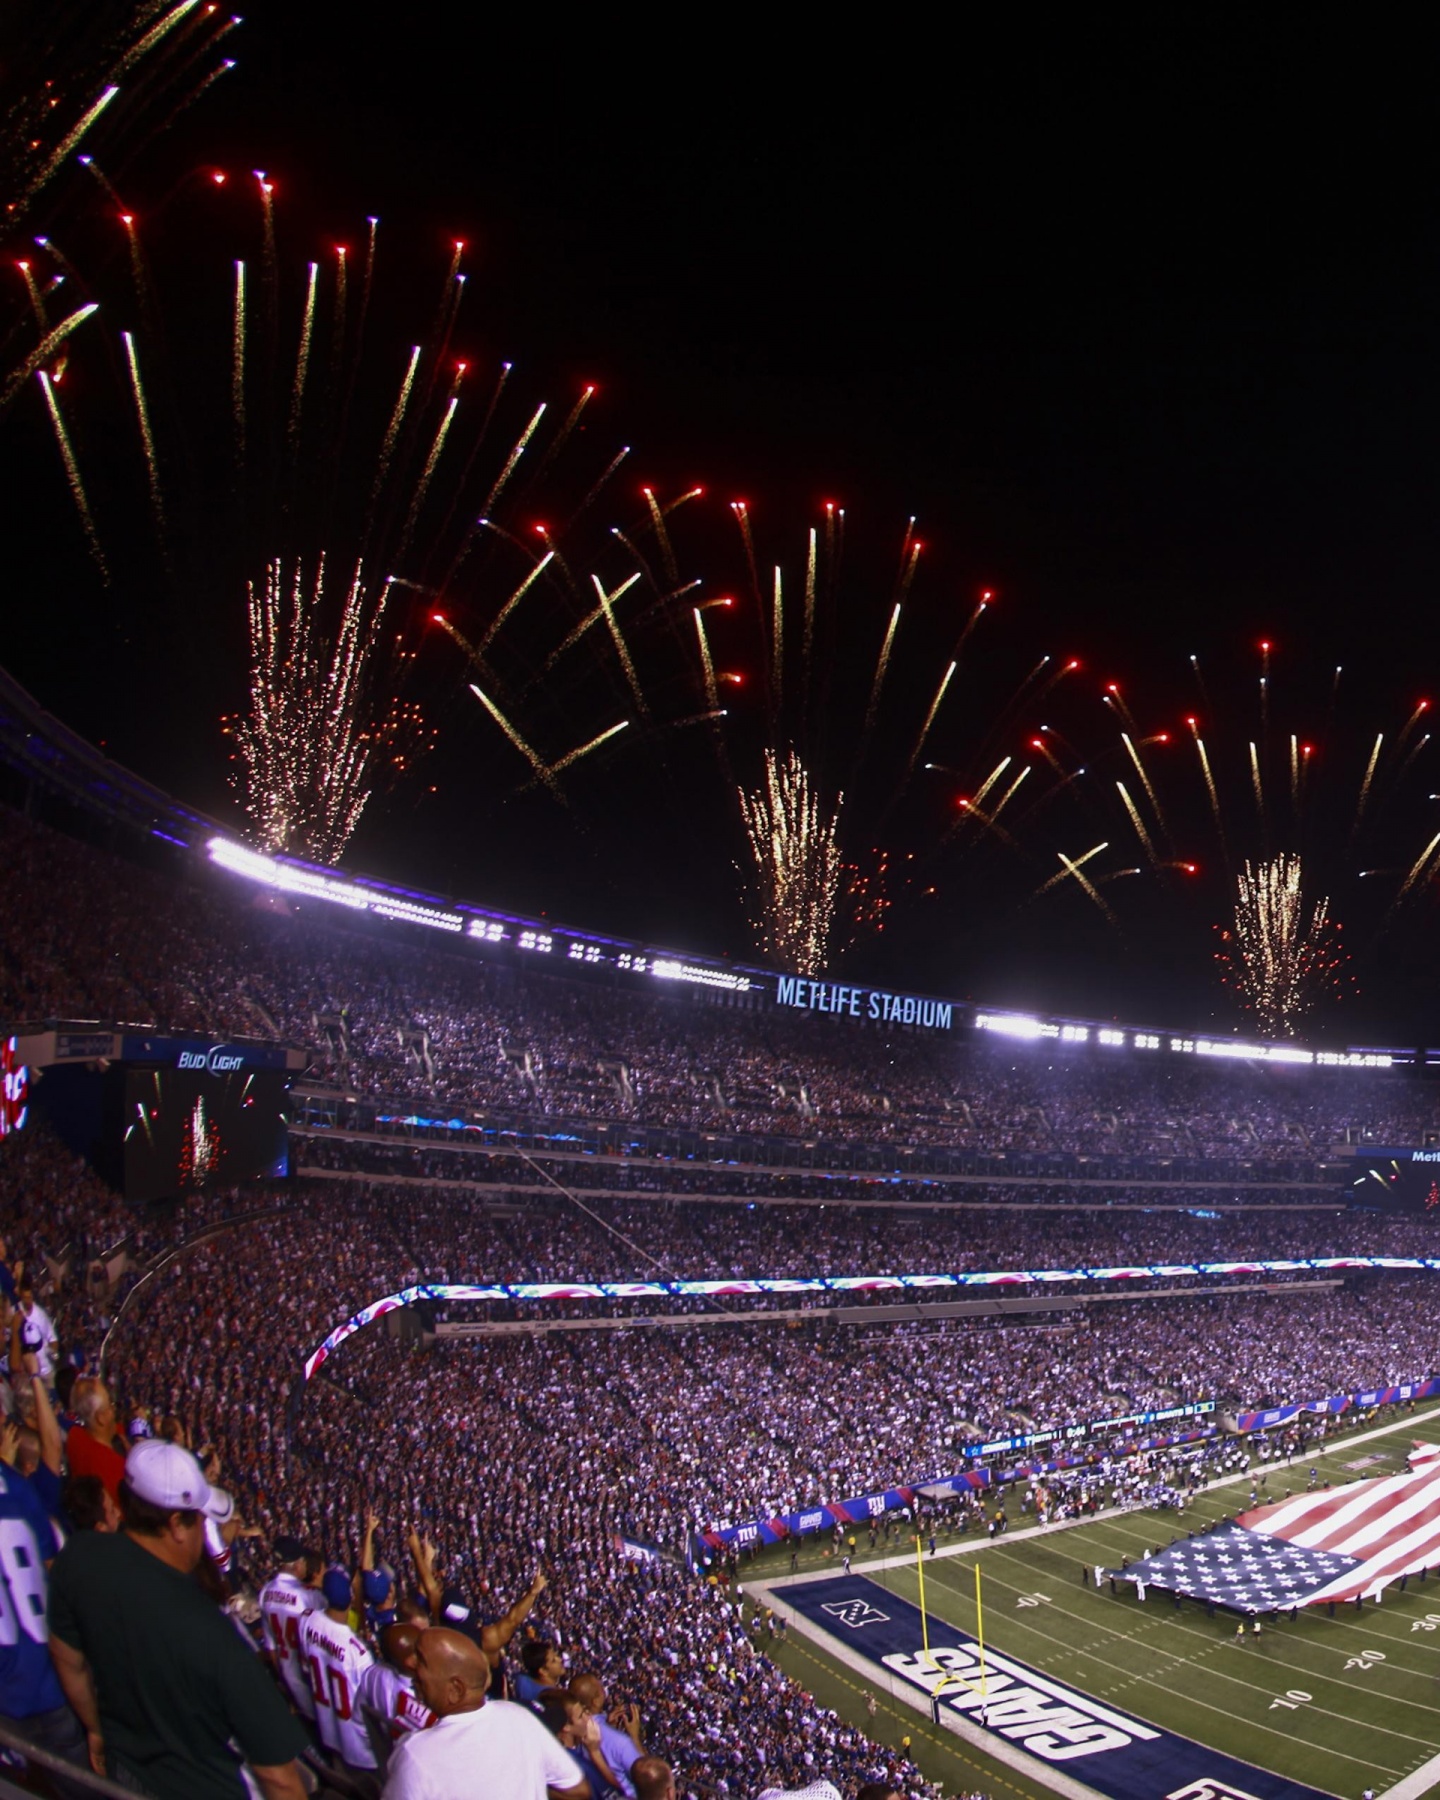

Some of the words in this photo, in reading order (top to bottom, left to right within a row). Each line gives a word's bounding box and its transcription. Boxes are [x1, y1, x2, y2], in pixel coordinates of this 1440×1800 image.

[776, 976, 863, 1017] METLIFE
[867, 991, 953, 1030] STADIUM
[177, 1051, 206, 1069] BUD
[211, 1054, 244, 1071] LIGHT
[306, 1626, 346, 1663] MANNING
[1347, 1650, 1386, 1670] 20
[309, 1655, 352, 1721] 10
[882, 1643, 1162, 1761] GIANTS
[1274, 1690, 1313, 1710] 10
